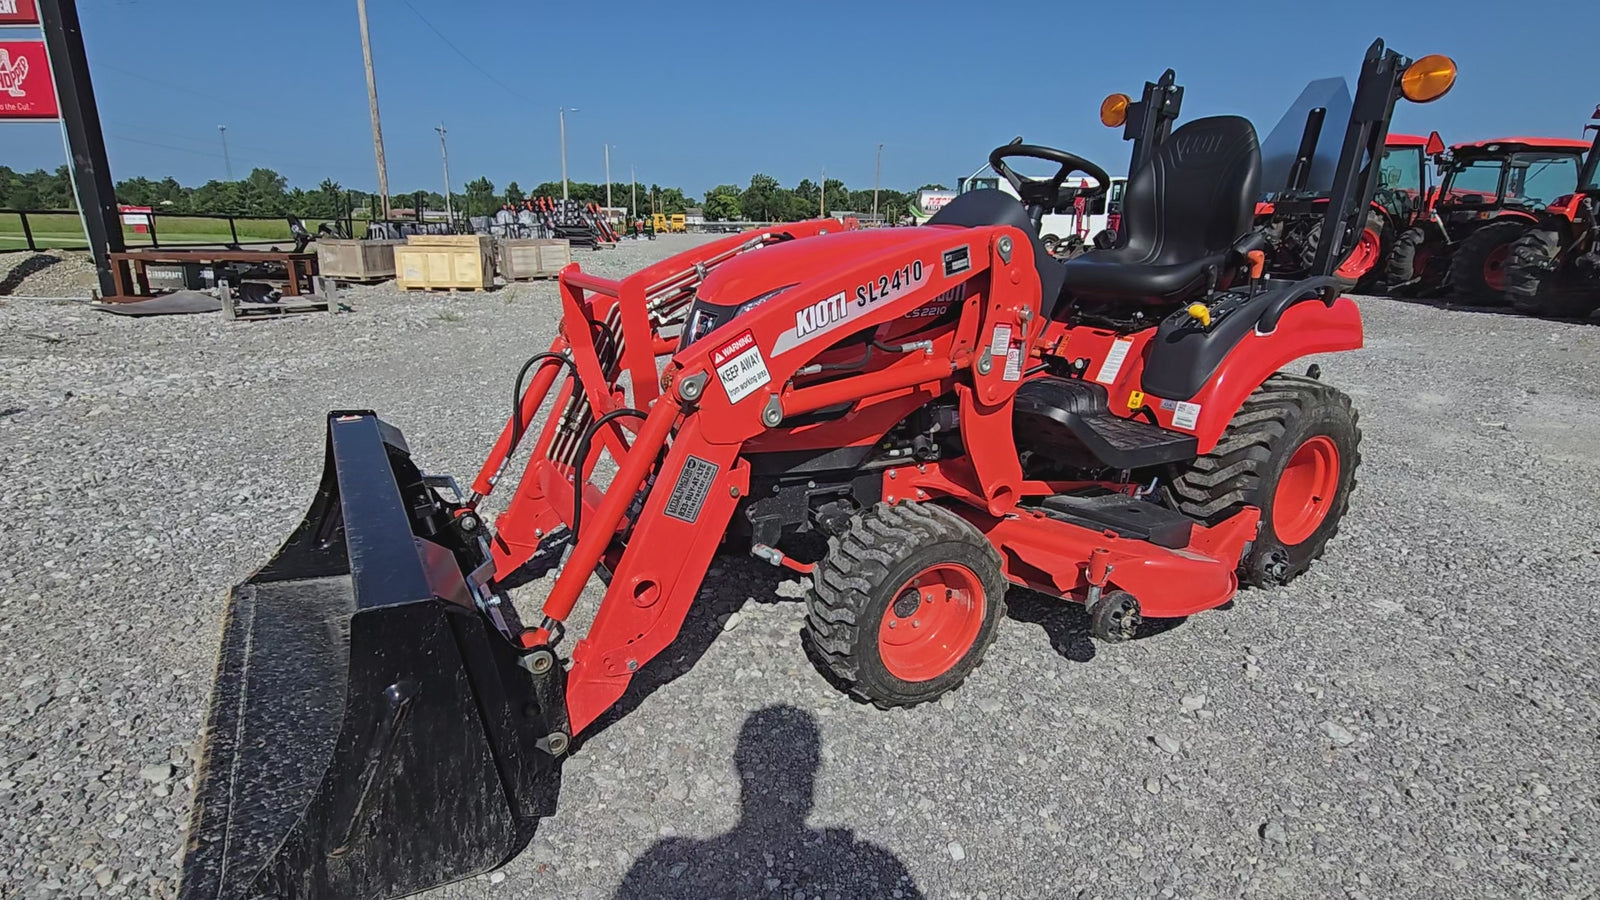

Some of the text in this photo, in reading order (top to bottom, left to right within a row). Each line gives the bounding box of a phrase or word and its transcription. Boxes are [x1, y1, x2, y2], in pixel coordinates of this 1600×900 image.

[795, 260, 923, 339] KIOTI SL2410
[721, 334, 753, 358] WARNING
[720, 352, 760, 384] KEEP AWAY
[728, 369, 767, 397] from working area
